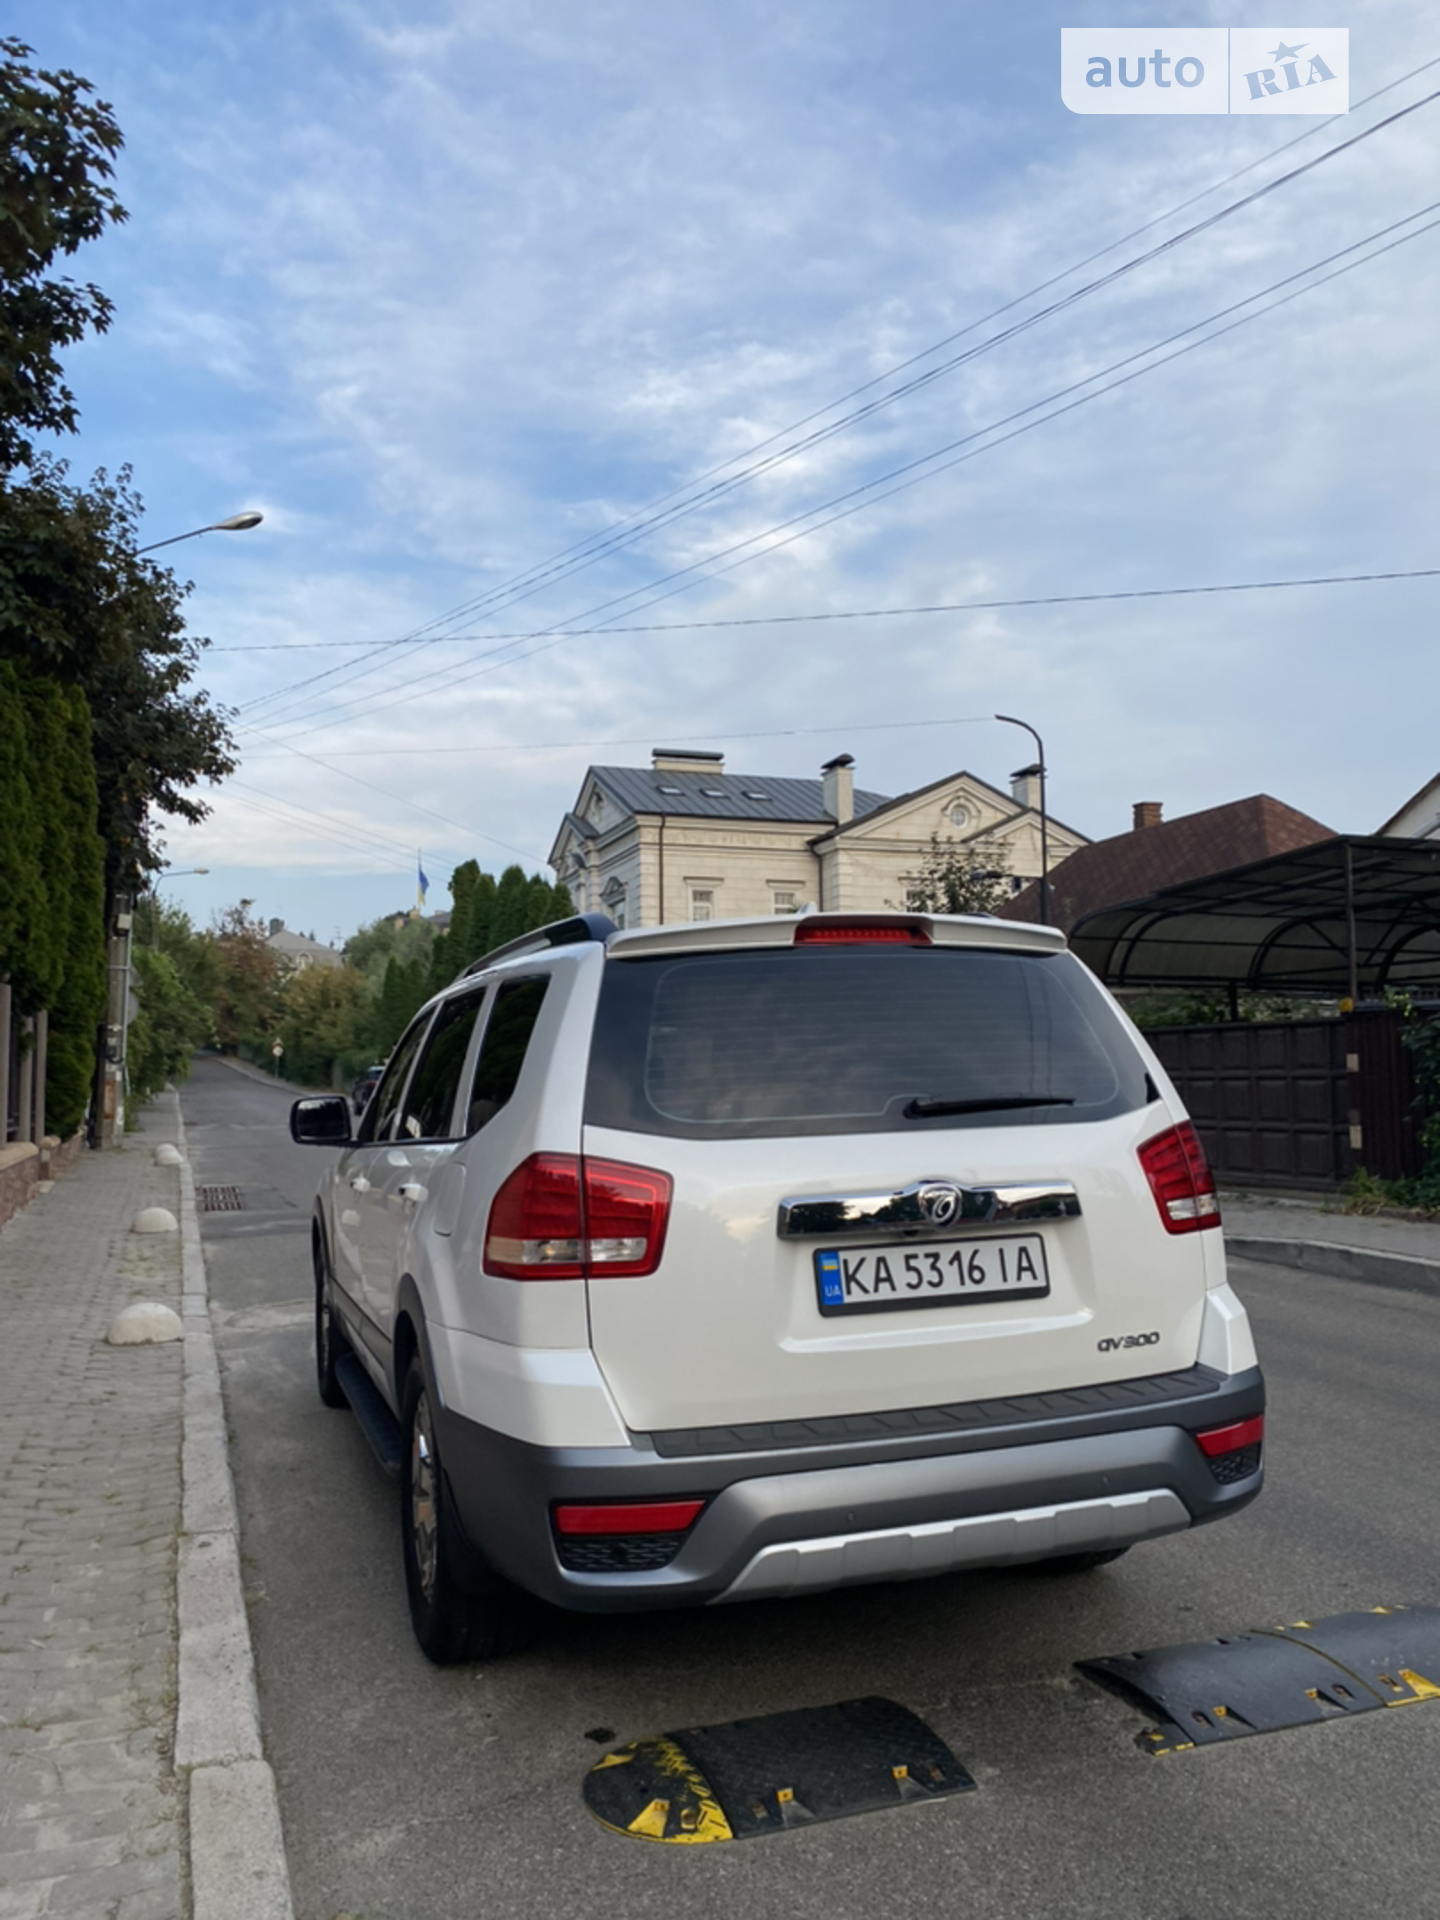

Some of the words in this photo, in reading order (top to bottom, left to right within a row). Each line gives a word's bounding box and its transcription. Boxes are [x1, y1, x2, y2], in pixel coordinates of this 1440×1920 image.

[842, 1256, 898, 1296] KA
[903, 1250, 986, 1291] 5316
[998, 1246, 1039, 1283] IA
[823, 1284, 842, 1297] UA
